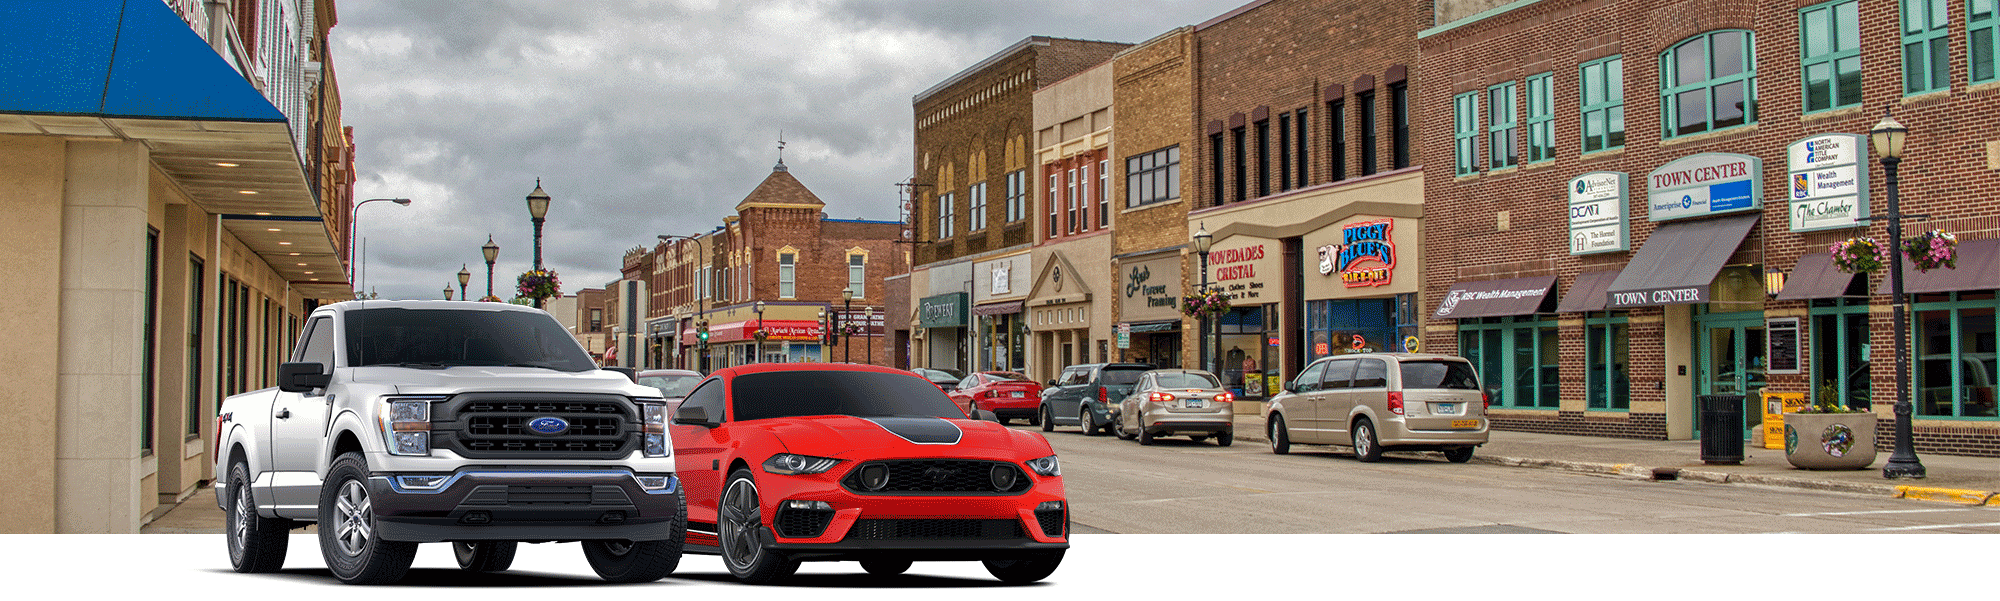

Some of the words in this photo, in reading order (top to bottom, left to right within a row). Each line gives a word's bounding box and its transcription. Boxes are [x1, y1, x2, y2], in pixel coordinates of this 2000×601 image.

[1815, 138, 1831, 146] NORTH
[1815, 143, 1839, 151] AMERICAN
[1815, 154, 1838, 162] COMPANY
[1654, 170, 1691, 188] TOWN
[1695, 162, 1747, 182] CENTER
[1817, 171, 1837, 180] Wealth
[1817, 178, 1854, 189] Management
[1653, 201, 1681, 211] Ameriprise
[1797, 203, 1815, 227] The
[1817, 200, 1852, 215] Chamber
[1343, 223, 1386, 246] PIGGY
[1208, 245, 1264, 266] NOVEDADES
[1340, 242, 1390, 271] BLUE'S
[1217, 264, 1256, 281] CRISTAL
[1142, 285, 1166, 296] Forever
[1461, 291, 1477, 300] RBC
[1476, 290, 1500, 299] Wealth
[1499, 288, 1546, 299] Management
[1614, 292, 1647, 305] TOWN
[1652, 288, 1699, 303] CENTER
[1147, 294, 1177, 309] Framing
[924, 302, 954, 320] BREWERY
